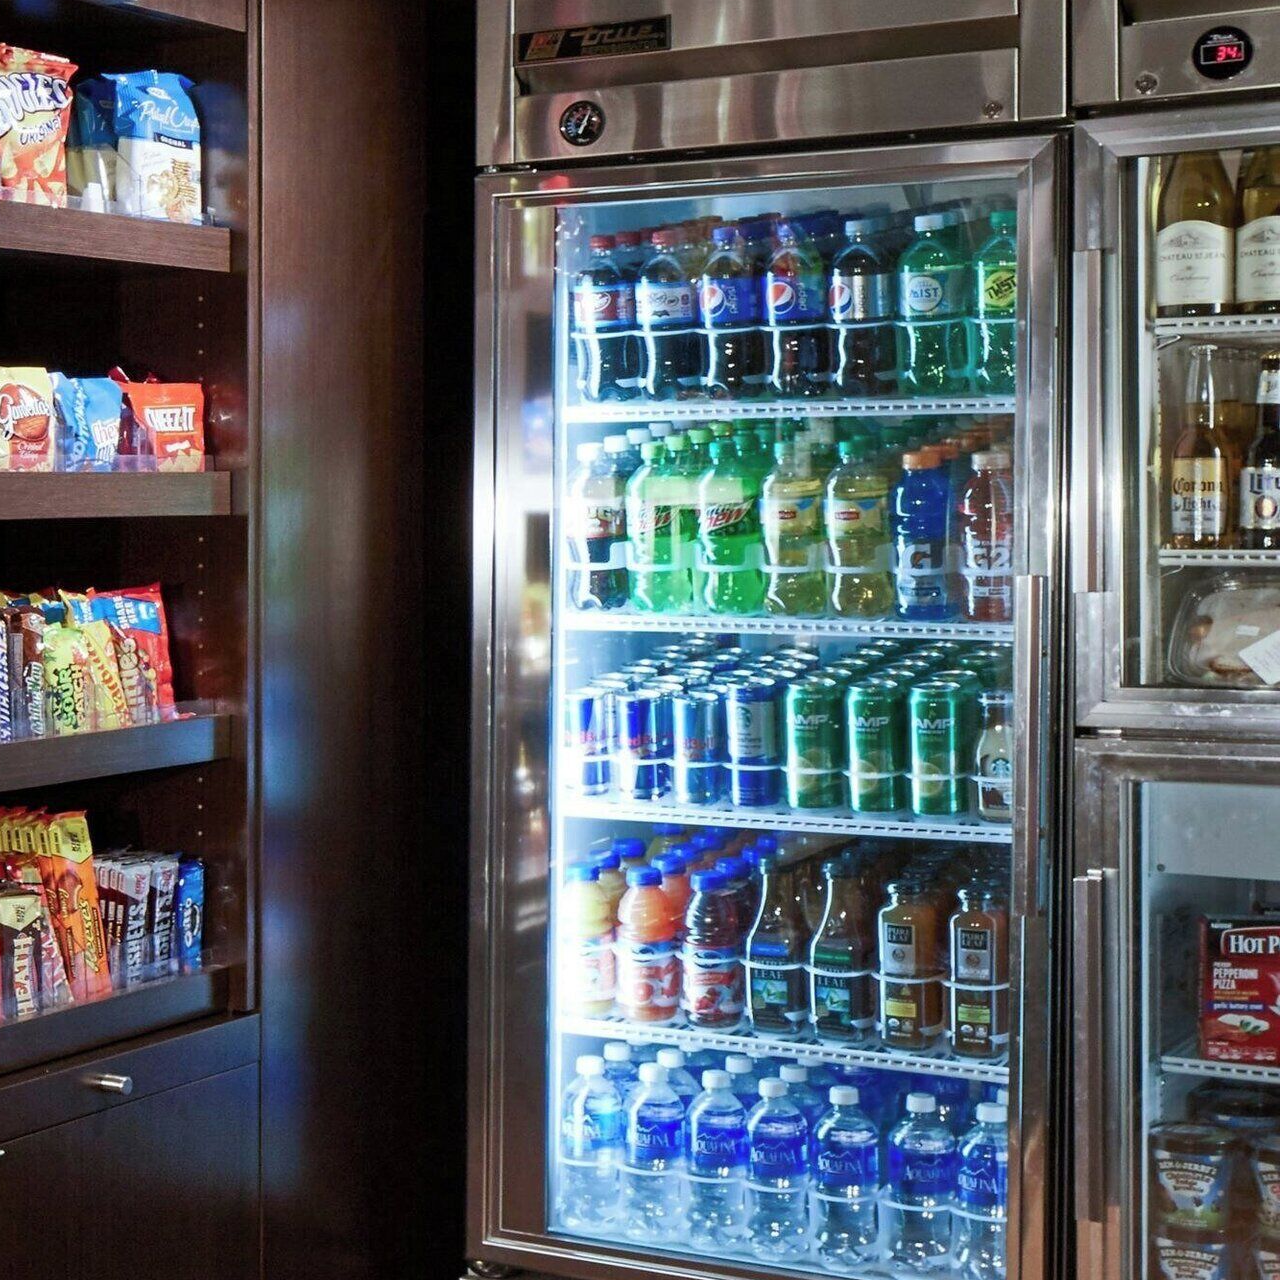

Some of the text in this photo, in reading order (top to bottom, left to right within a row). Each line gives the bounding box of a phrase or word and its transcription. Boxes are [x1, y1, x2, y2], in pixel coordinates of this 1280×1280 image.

[59, 667, 78, 729] SOUR
[71, 664, 85, 724] PATCH
[80, 897, 100, 973] Reese's
[1229, 934, 1266, 954] HOT
[13, 933, 36, 1016] HEATH
[754, 970, 784, 979] LEAF
[817, 977, 847, 987] LEAF
[1213, 979, 1236, 990] PIZZA
